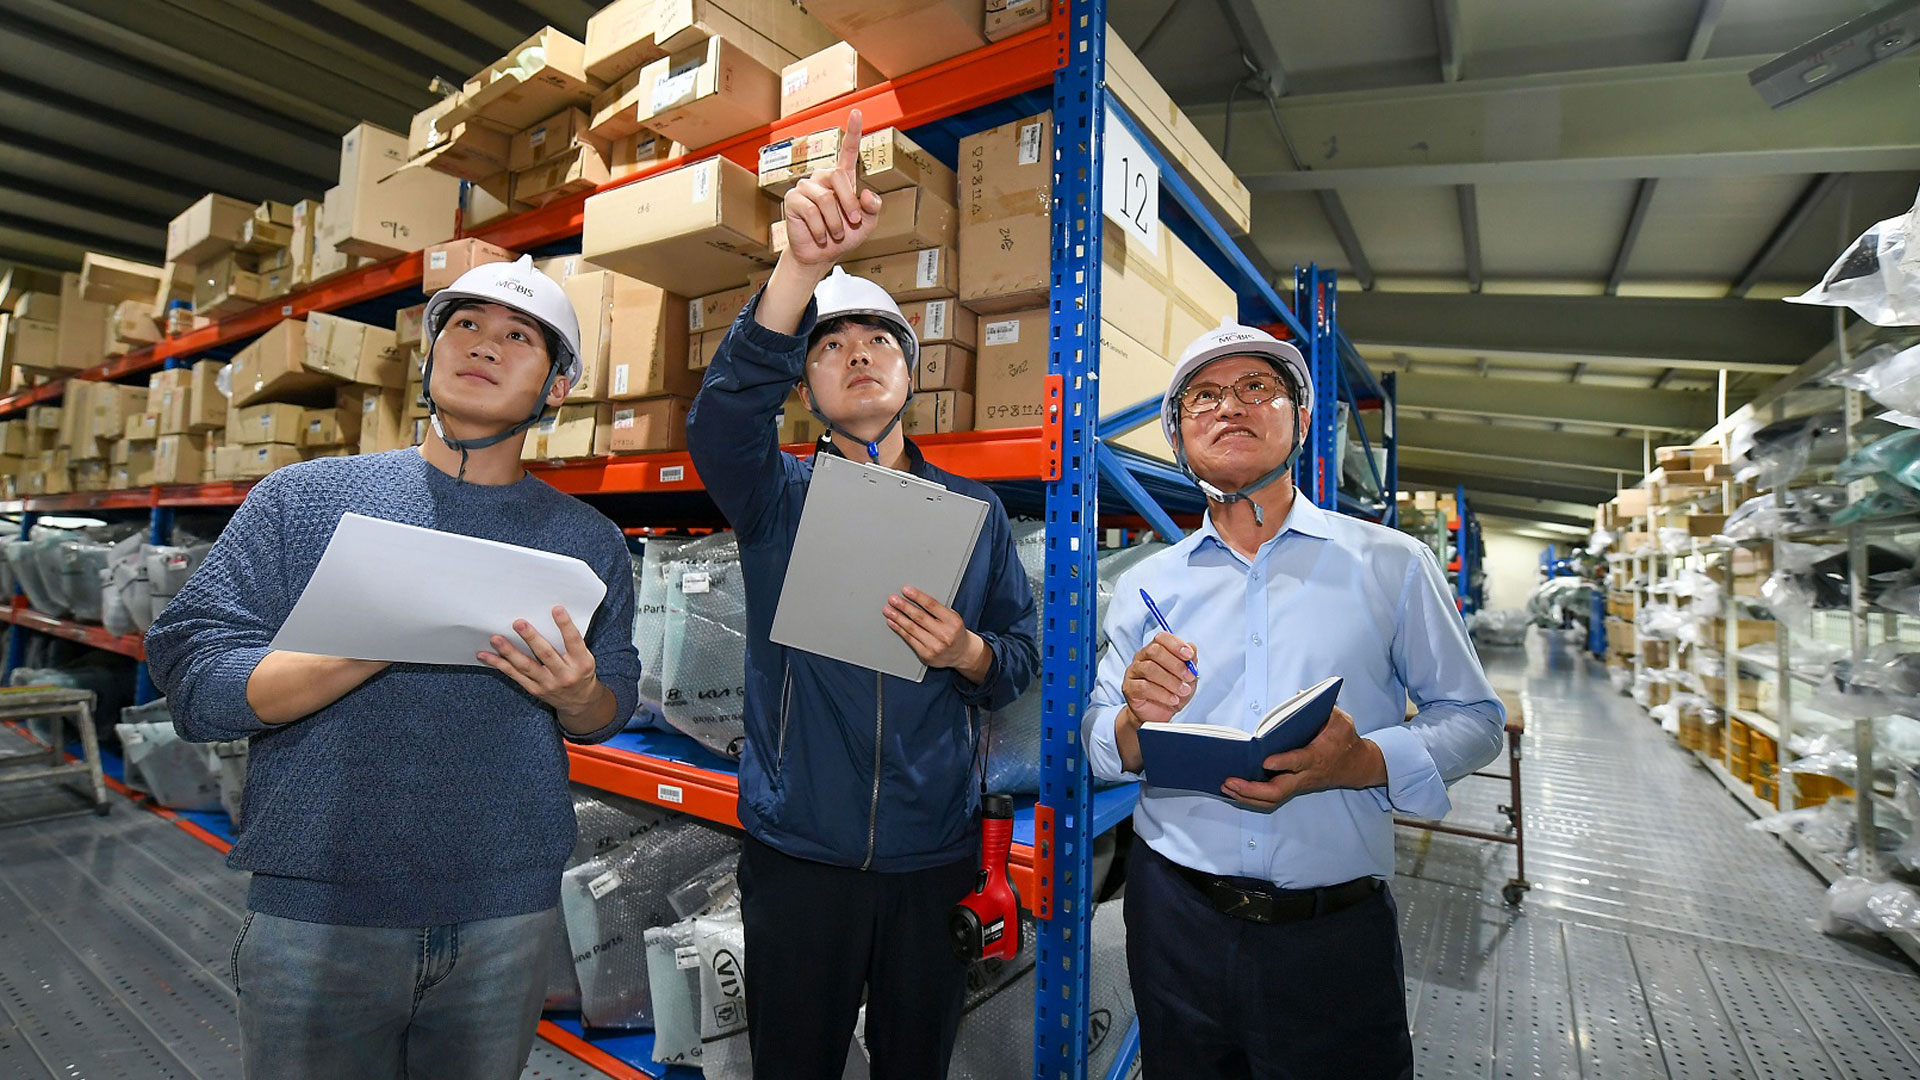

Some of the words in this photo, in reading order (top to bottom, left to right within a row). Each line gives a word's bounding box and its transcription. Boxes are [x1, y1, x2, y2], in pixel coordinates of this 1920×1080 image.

[1120, 157, 1148, 234] 12
[496, 280, 534, 298] MOBIS
[1218, 334, 1255, 343] MOBIS
